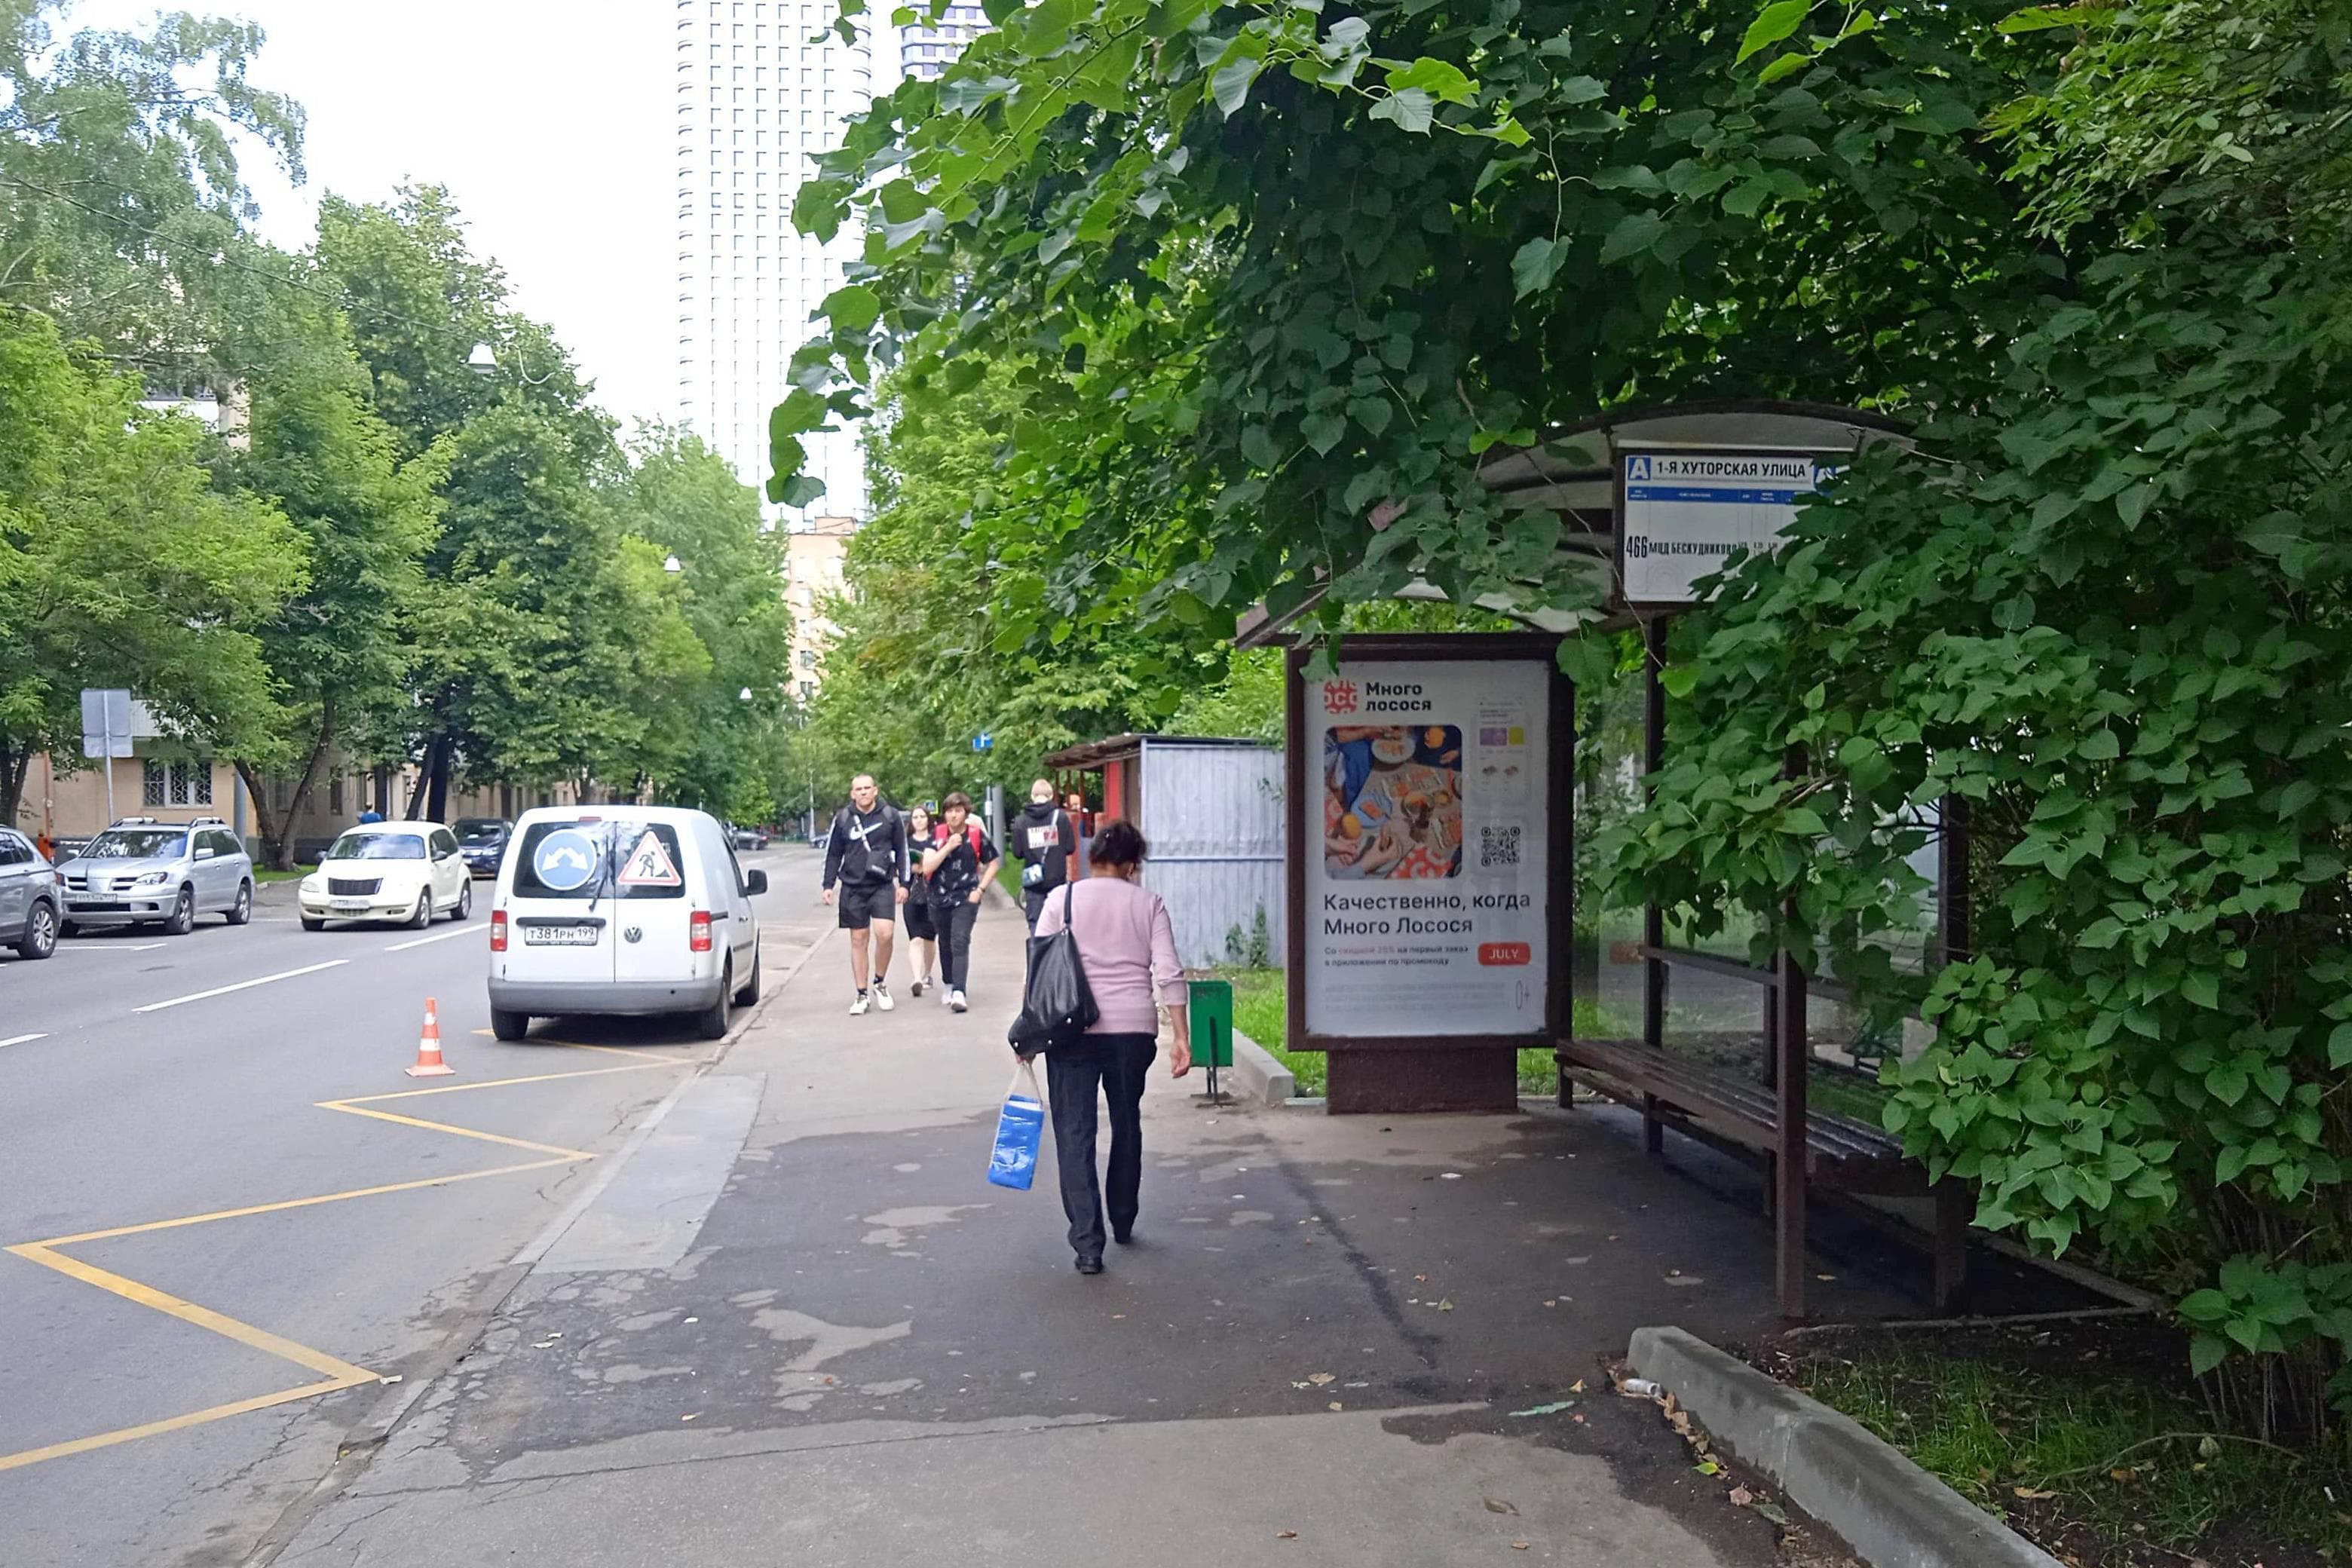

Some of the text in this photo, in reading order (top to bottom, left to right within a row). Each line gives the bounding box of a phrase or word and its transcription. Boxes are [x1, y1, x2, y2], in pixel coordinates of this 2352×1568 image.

[1658, 461, 1677, 474] 1-Я
[1681, 461, 1758, 476] ХУТОРСКАЯ
[1762, 463, 1806, 479] УЛИЦА
[1626, 535, 1648, 558] 466
[1365, 681, 1423, 696] Много
[1365, 700, 1432, 712] лосося
[1324, 893, 1531, 913] Качественно, когда
[1324, 917, 1473, 936] Много Лосося
[1489, 949, 1519, 960] JULY
